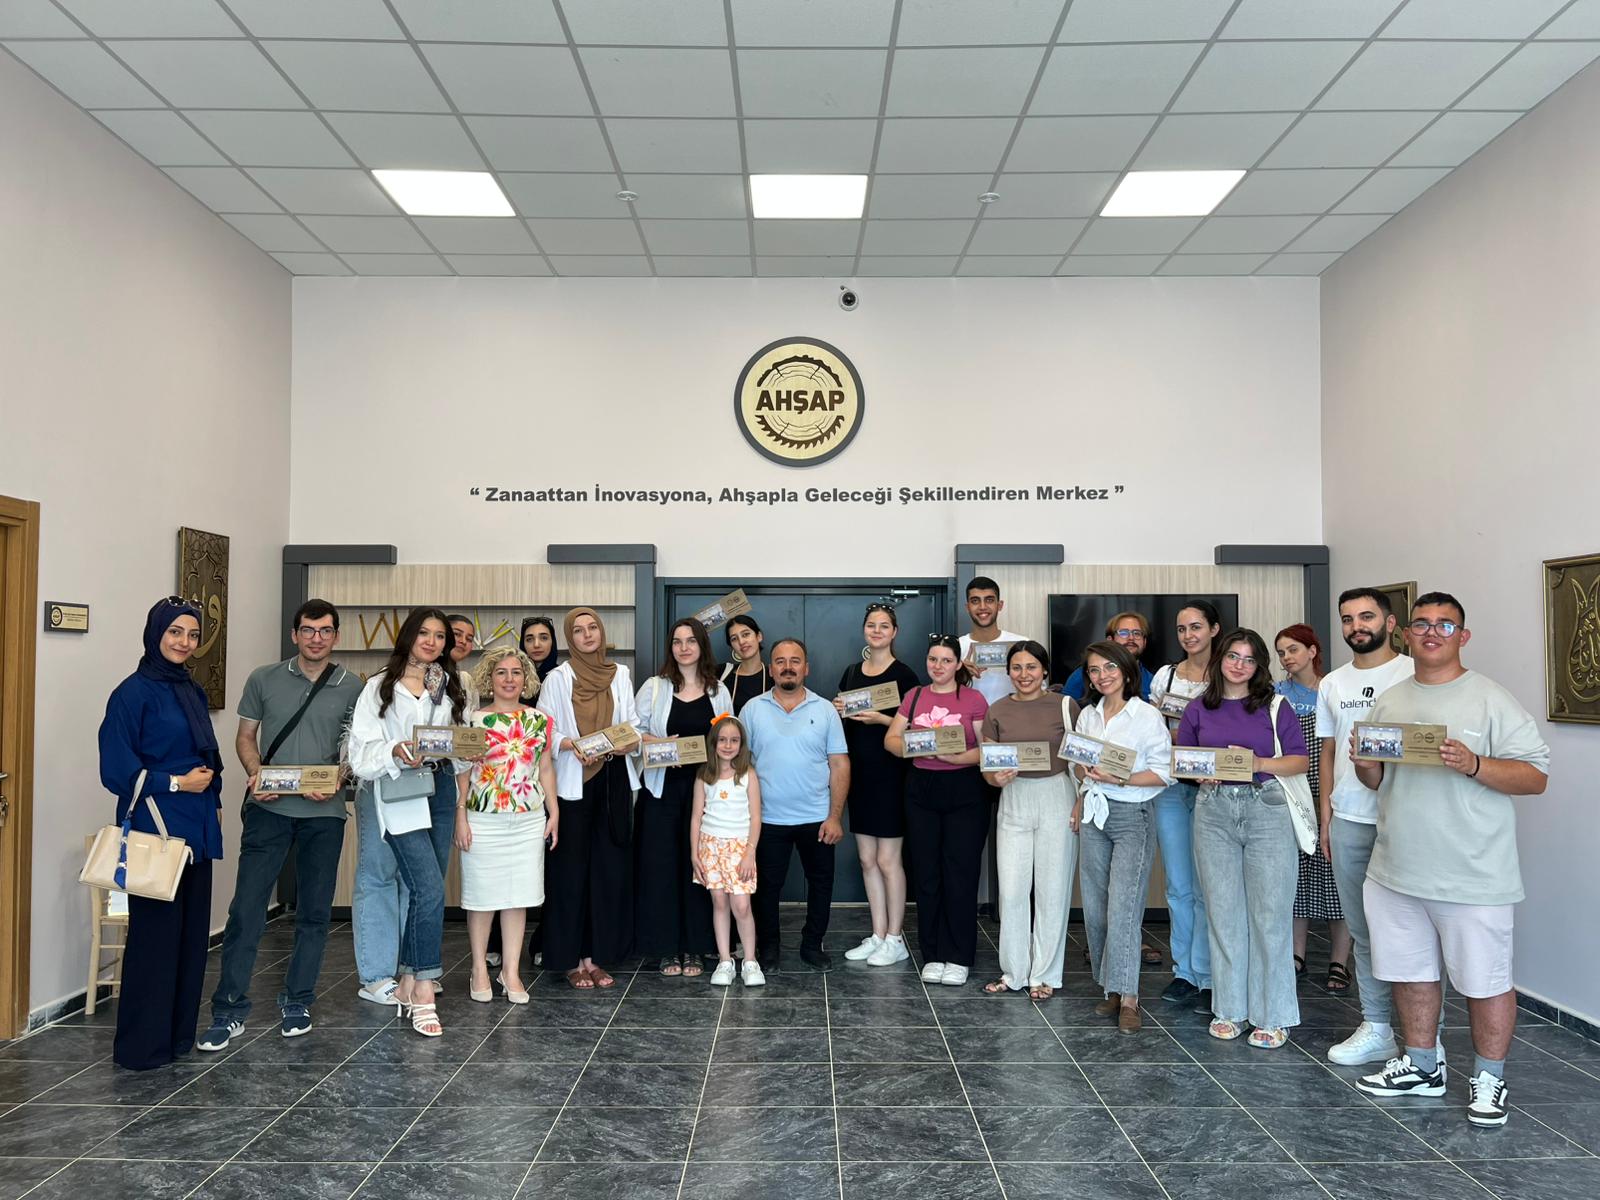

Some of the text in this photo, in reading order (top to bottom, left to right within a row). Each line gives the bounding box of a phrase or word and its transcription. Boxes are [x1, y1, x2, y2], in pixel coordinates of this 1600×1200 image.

[755, 390, 845, 415] AHŞAP
[485, 487, 588, 502] Zanaattan
[595, 484, 713, 505] İnovasyona,
[718, 487, 799, 505] Ahşapla
[805, 487, 892, 505] Geleceği
[898, 486, 1029, 505] Şekillendiren
[1036, 486, 1109, 500] Merkez
